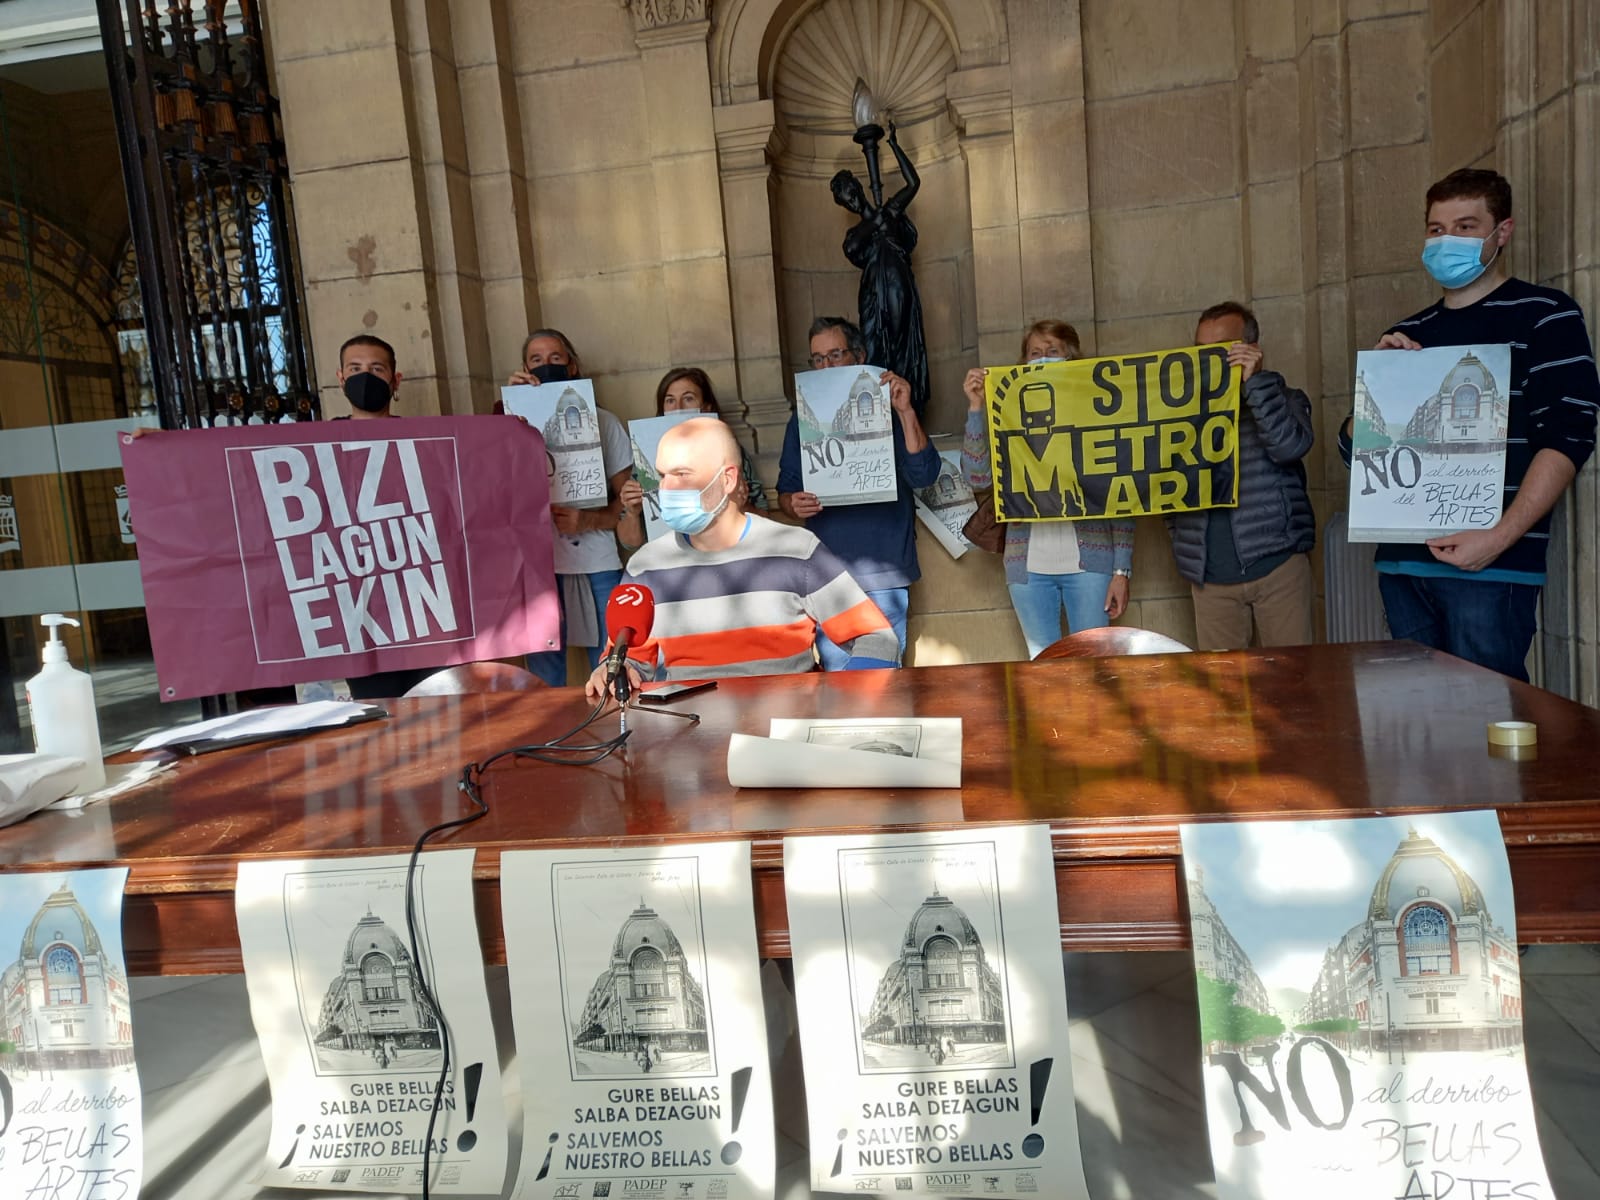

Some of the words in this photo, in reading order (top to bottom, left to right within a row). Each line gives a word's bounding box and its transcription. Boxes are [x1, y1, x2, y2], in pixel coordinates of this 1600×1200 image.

[1092, 346, 1231, 421] STOP
[801, 437, 845, 475] NO
[1007, 415, 1235, 493] METRO
[558, 467, 601, 485] BELLAS
[846, 458, 891, 476] BELLAS
[1355, 445, 1422, 496] NO
[1423, 463, 1445, 477] al
[1447, 463, 1501, 477] derribo
[251, 440, 430, 539] BIZI
[566, 482, 604, 498] ARTES
[852, 474, 893, 491] ARTES
[1104, 468, 1213, 516] ARI
[1392, 493, 1415, 506] del
[1422, 482, 1496, 503] BELLAS
[1429, 503, 1498, 526] ARTES
[275, 512, 443, 591] LAGUN
[289, 563, 458, 659] EKIN
[350, 1082, 394, 1097] GURE
[607, 1088, 655, 1103] GURE
[661, 1086, 720, 1102] BELLAS
[897, 1081, 948, 1098] GURE
[954, 1077, 1019, 1095] BELLAS
[1208, 1035, 1354, 1146] NO
[1361, 1072, 1404, 1105] al
[1406, 1074, 1522, 1105] derribo
[18, 1086, 52, 1114] al
[53, 1086, 136, 1113] derribo
[320, 1100, 371, 1116] SALBA
[862, 1101, 922, 1119] SALBA
[927, 1097, 1020, 1116] DEZAGUN
[574, 1106, 630, 1124] SALBA
[635, 1104, 722, 1121] DEZAGUN
[312, 1121, 404, 1140] SALVEMOS
[566, 1130, 663, 1149] SALVEMOS
[856, 1124, 959, 1146] SALVEMOS
[16, 1123, 131, 1165] BELLAS
[308, 1140, 386, 1160] NUESTRO
[1361, 1118, 1522, 1168] BELLAS
[565, 1152, 645, 1170] NUESTRO
[651, 1149, 712, 1168] BELLAS
[858, 1146, 943, 1167] NUESTRO
[949, 1143, 1014, 1162] BELLAS
[25, 1165, 137, 1200] ARTES
[361, 1167, 405, 1178] PADEP
[925, 1174, 971, 1186] PADEP
[623, 1179, 668, 1191] PADEP
